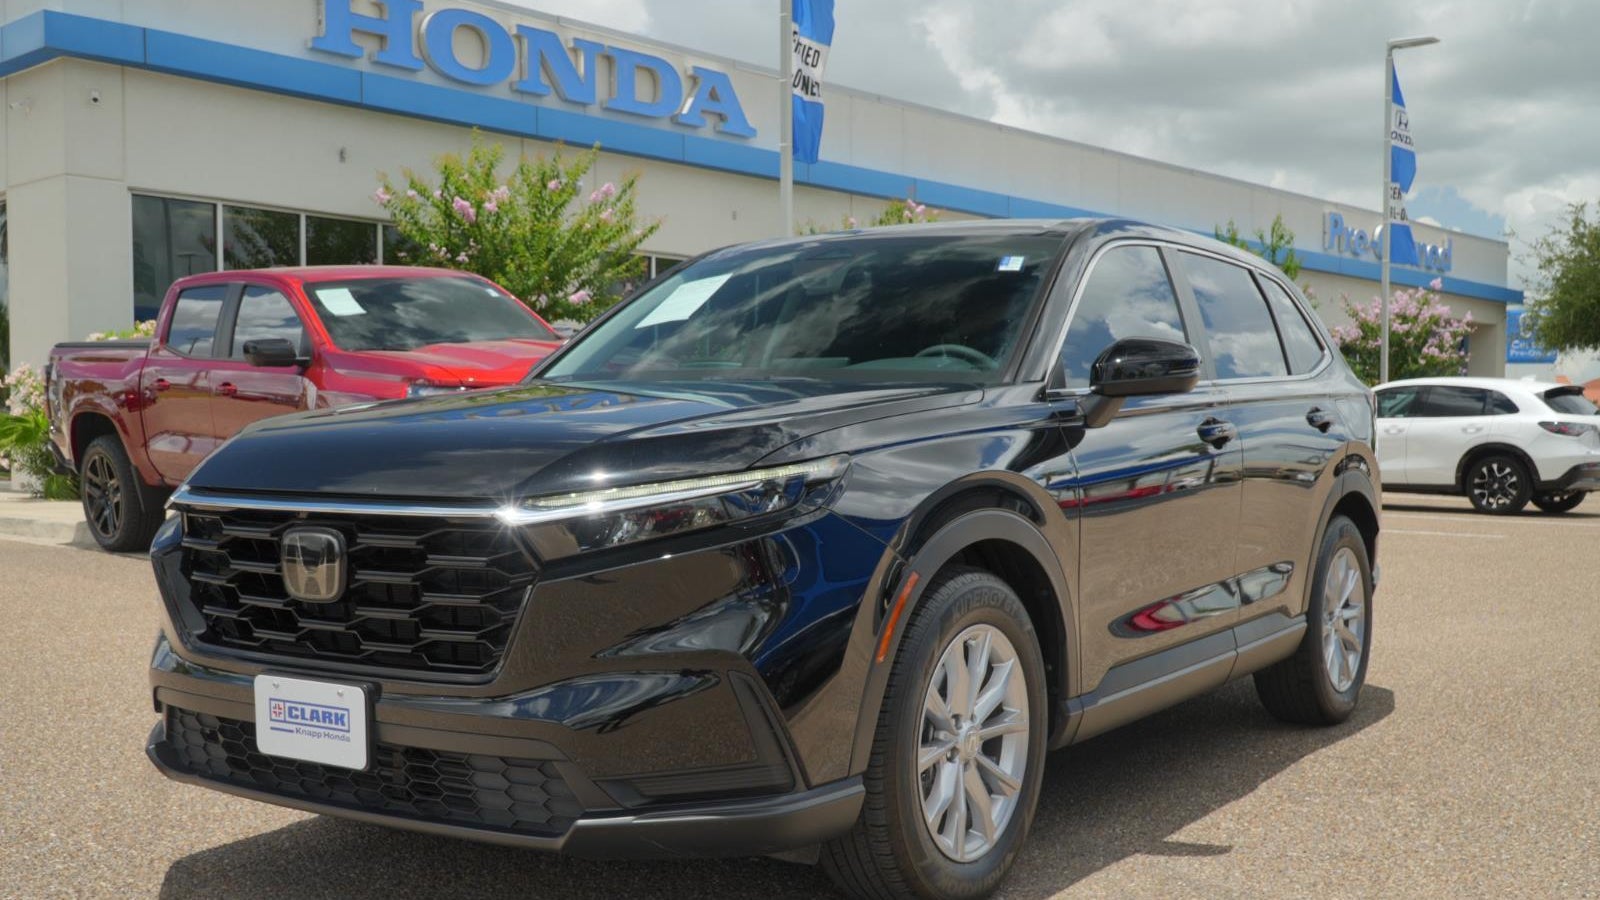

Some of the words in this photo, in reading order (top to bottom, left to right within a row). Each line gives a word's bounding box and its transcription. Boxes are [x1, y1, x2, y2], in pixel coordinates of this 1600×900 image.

[307, 0, 757, 138] HONDA
[1391, 131, 1414, 146] OND
[287, 706, 346, 727] CLARK
[295, 727, 322, 739] Knapp
[323, 731, 351, 743] Honda
